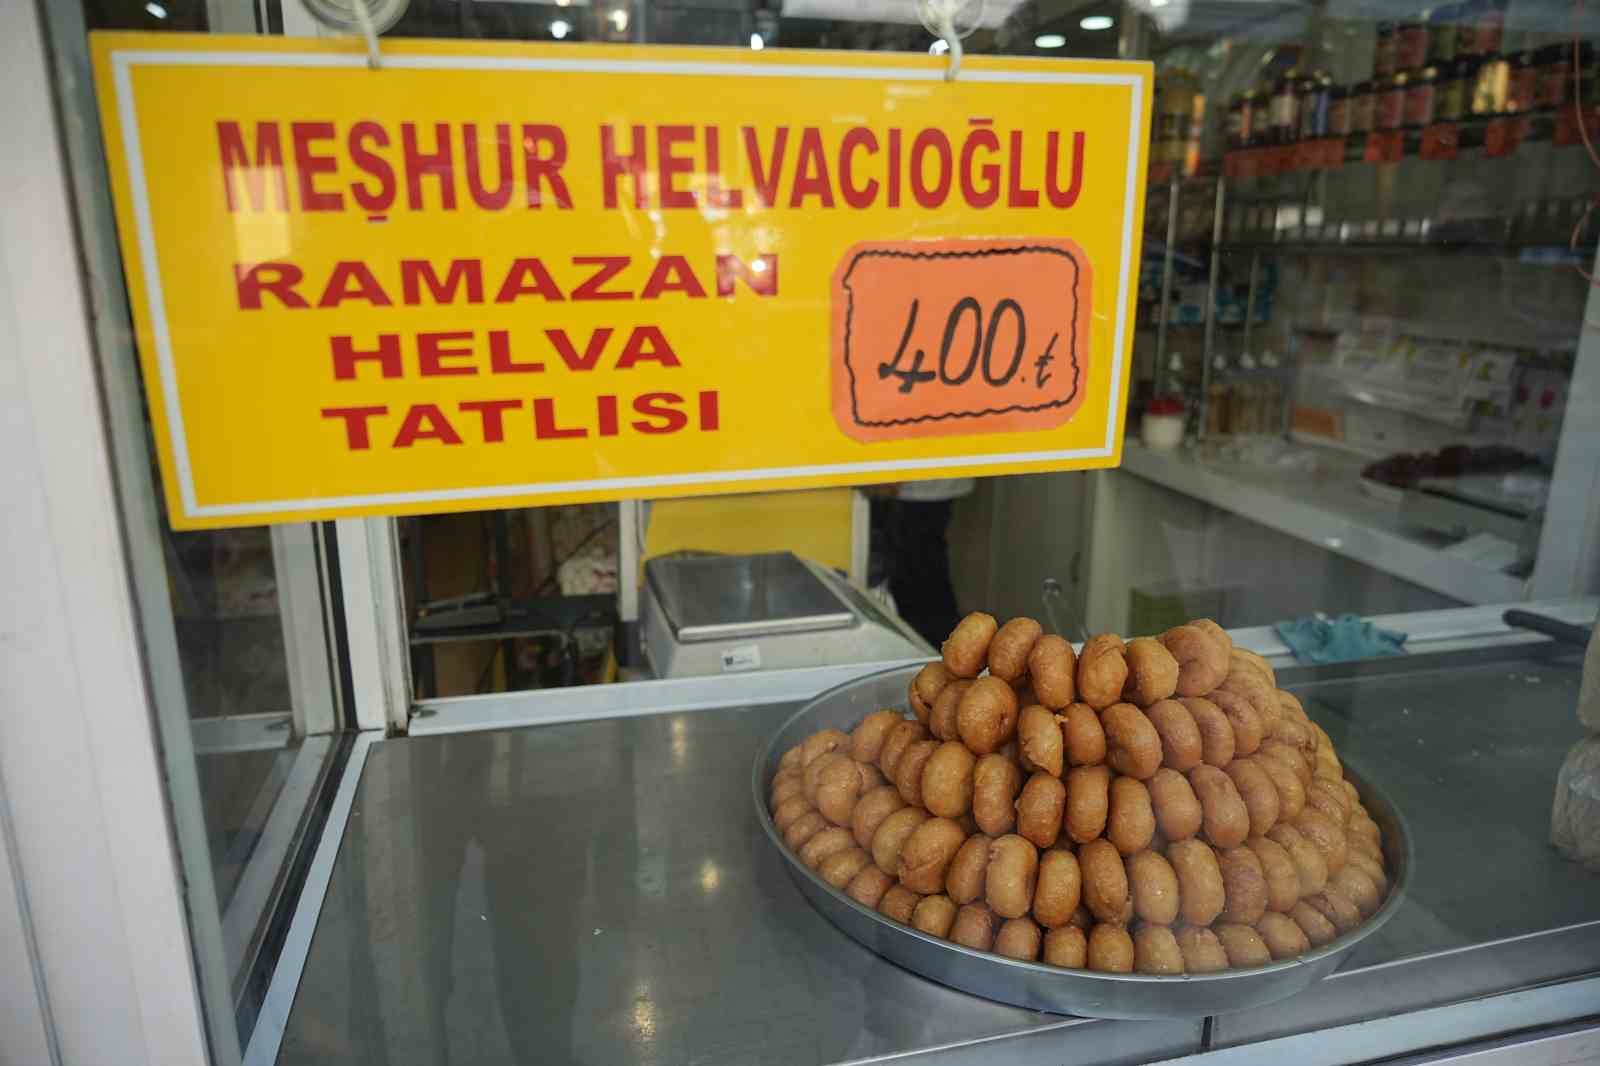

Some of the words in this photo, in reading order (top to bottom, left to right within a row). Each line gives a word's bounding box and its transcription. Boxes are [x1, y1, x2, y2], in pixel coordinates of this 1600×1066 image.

[216, 120, 575, 223] MEŞHUR
[600, 117, 1086, 211] HELVACIOĞLU
[234, 254, 780, 311] RAMAZAN
[330, 325, 681, 381] HELVA
[321, 390, 721, 451] TATLISI
